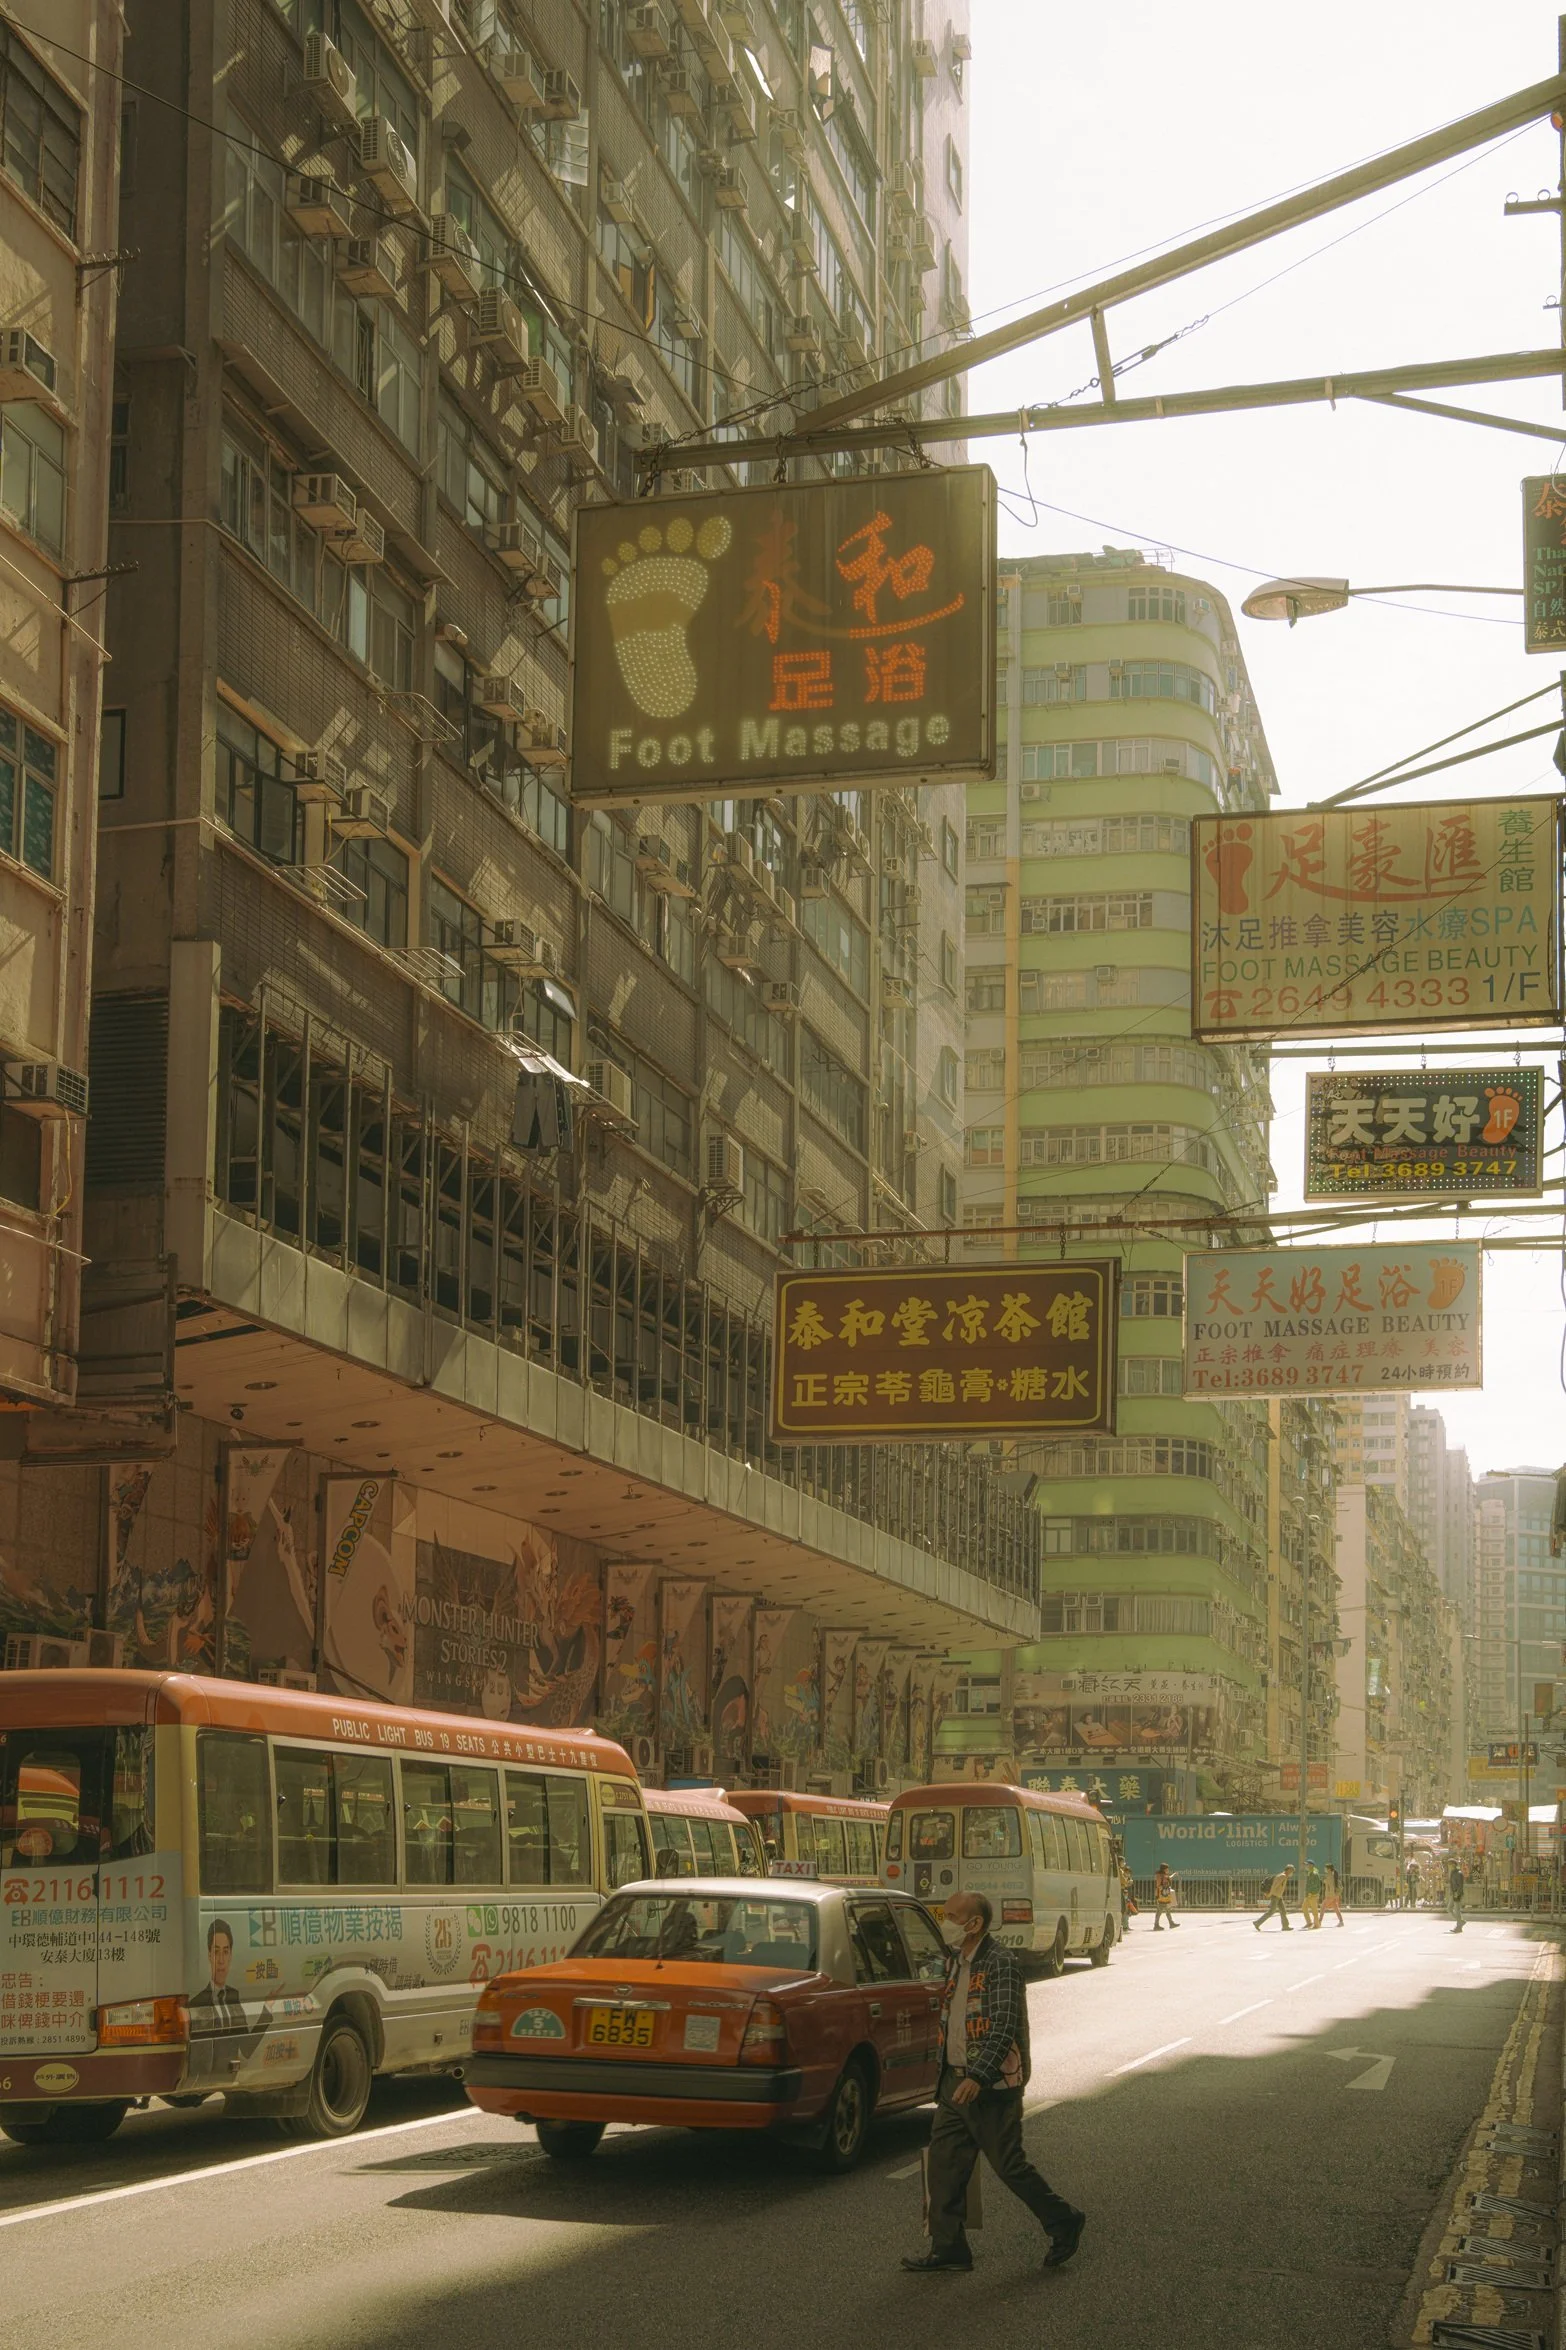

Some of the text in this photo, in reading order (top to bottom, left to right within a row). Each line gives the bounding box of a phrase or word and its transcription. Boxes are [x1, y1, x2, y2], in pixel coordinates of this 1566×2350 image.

[608, 714, 951, 770] Foot Massage
[1497, 809, 1535, 893] 養生館
[1203, 944, 1538, 983] FOOT MASSAGE BEAUTY
[1250, 972, 1541, 1016] 2649 4333 1/F
[1330, 1095, 1480, 1144] 天天好
[1494, 1108, 1513, 1129] 1F
[1374, 1146, 1448, 1161] Massage
[1457, 1144, 1517, 1158] Beauty
[1382, 1162, 1445, 1177] 3689
[1453, 1160, 1517, 1176] 3747
[1205, 1263, 1421, 1315] 天天好足浴
[1193, 1313, 1470, 1340] FOOT MASSAGE BEAUTY
[1194, 1343, 1291, 1365] 正宗推拿
[1419, 1336, 1471, 1358] 美容
[1306, 1364, 1364, 1385] 3747
[1381, 1362, 1470, 1382] 24小時預約
[328, 1480, 378, 1577] CAPCOM
[402, 1593, 539, 1649] MONSTER HUNTER
[441, 1639, 497, 1669] STORIES
[426, 1671, 469, 1688] WINGS
[332, 1718, 370, 1740] PUBLIC
[378, 1724, 406, 1745] LIGHT
[415, 1729, 433, 1748] BUS
[440, 1732, 450, 1749] 19
[456, 1734, 485, 1753] SEATS
[1226, 1840, 1268, 1848] LOGISTICS
[1279, 1837, 1299, 1847] Can
[773, 1861, 813, 1875] TAXI
[32, 1875, 165, 1903] 2116 1112
[502, 1905, 576, 1934] 9818 1100
[533, 2017, 544, 2029] 5
[609, 2008, 638, 2026] FW
[65, 2034, 86, 2043] 4899
[593, 2025, 650, 2045] 6835
